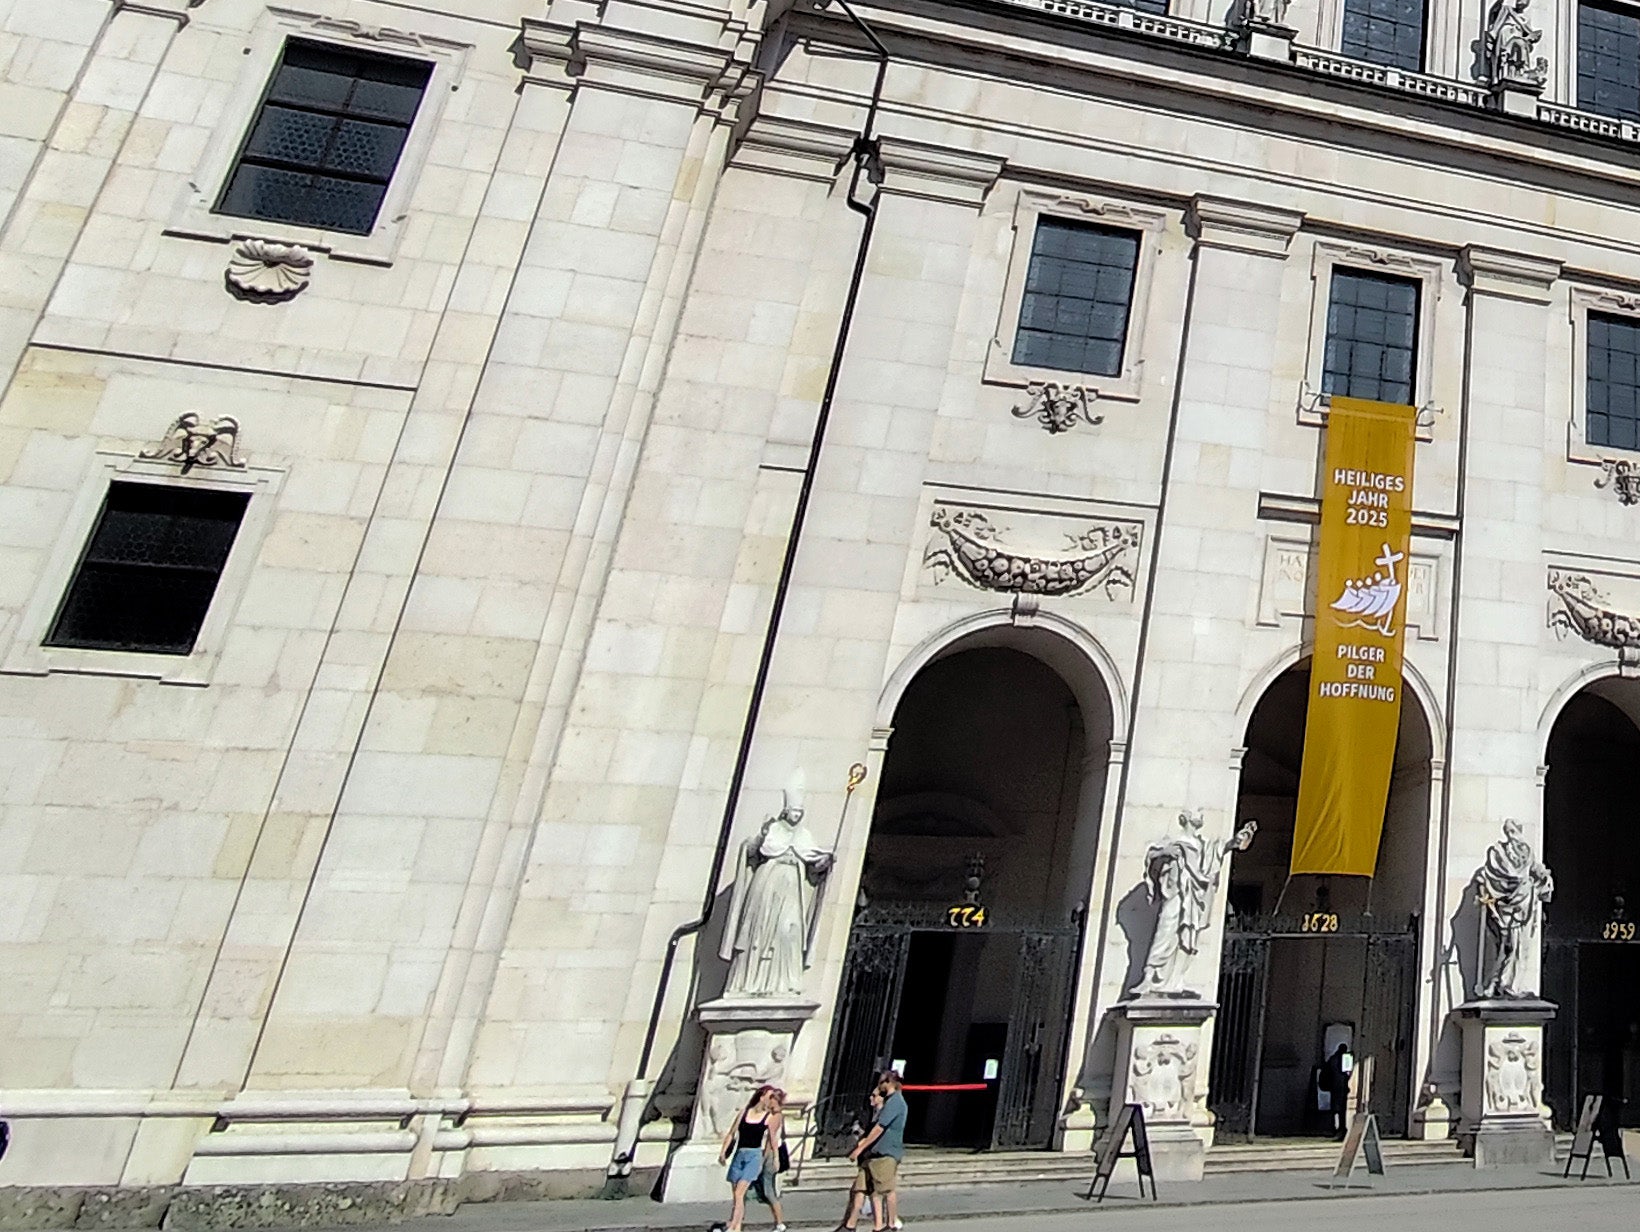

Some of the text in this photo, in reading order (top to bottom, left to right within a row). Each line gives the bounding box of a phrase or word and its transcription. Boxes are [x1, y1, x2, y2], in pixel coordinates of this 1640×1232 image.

[1333, 468, 1405, 492] HEILIGES
[1347, 489, 1388, 509] JAHR
[1345, 508, 1388, 528] 2025
[1336, 644, 1386, 663] PILGER
[1347, 663, 1375, 680] DER
[1319, 682, 1396, 702] HOFFNUNG
[947, 906, 985, 928] 774
[1301, 912, 1338, 932] 1628
[1603, 921, 1636, 940] 1959
